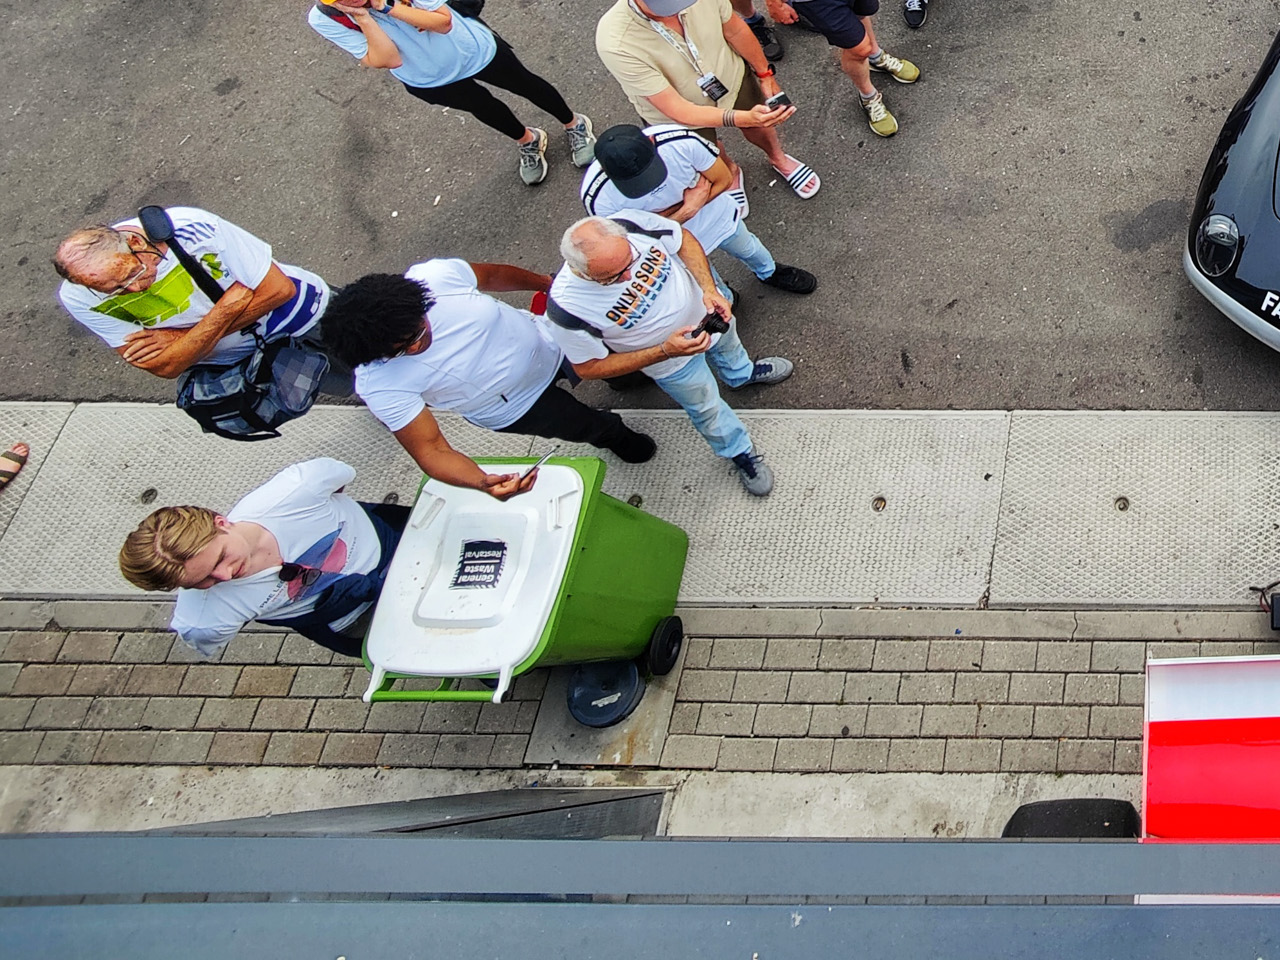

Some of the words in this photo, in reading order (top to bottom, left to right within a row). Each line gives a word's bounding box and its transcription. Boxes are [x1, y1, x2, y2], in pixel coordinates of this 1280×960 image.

[634, 245, 662, 284] SONS
[630, 281, 644, 293] &
[605, 287, 638, 323] ONLY
[464, 551, 503, 559] Restafval
[463, 564, 495, 574] Waste
[456, 574, 496, 584] General
